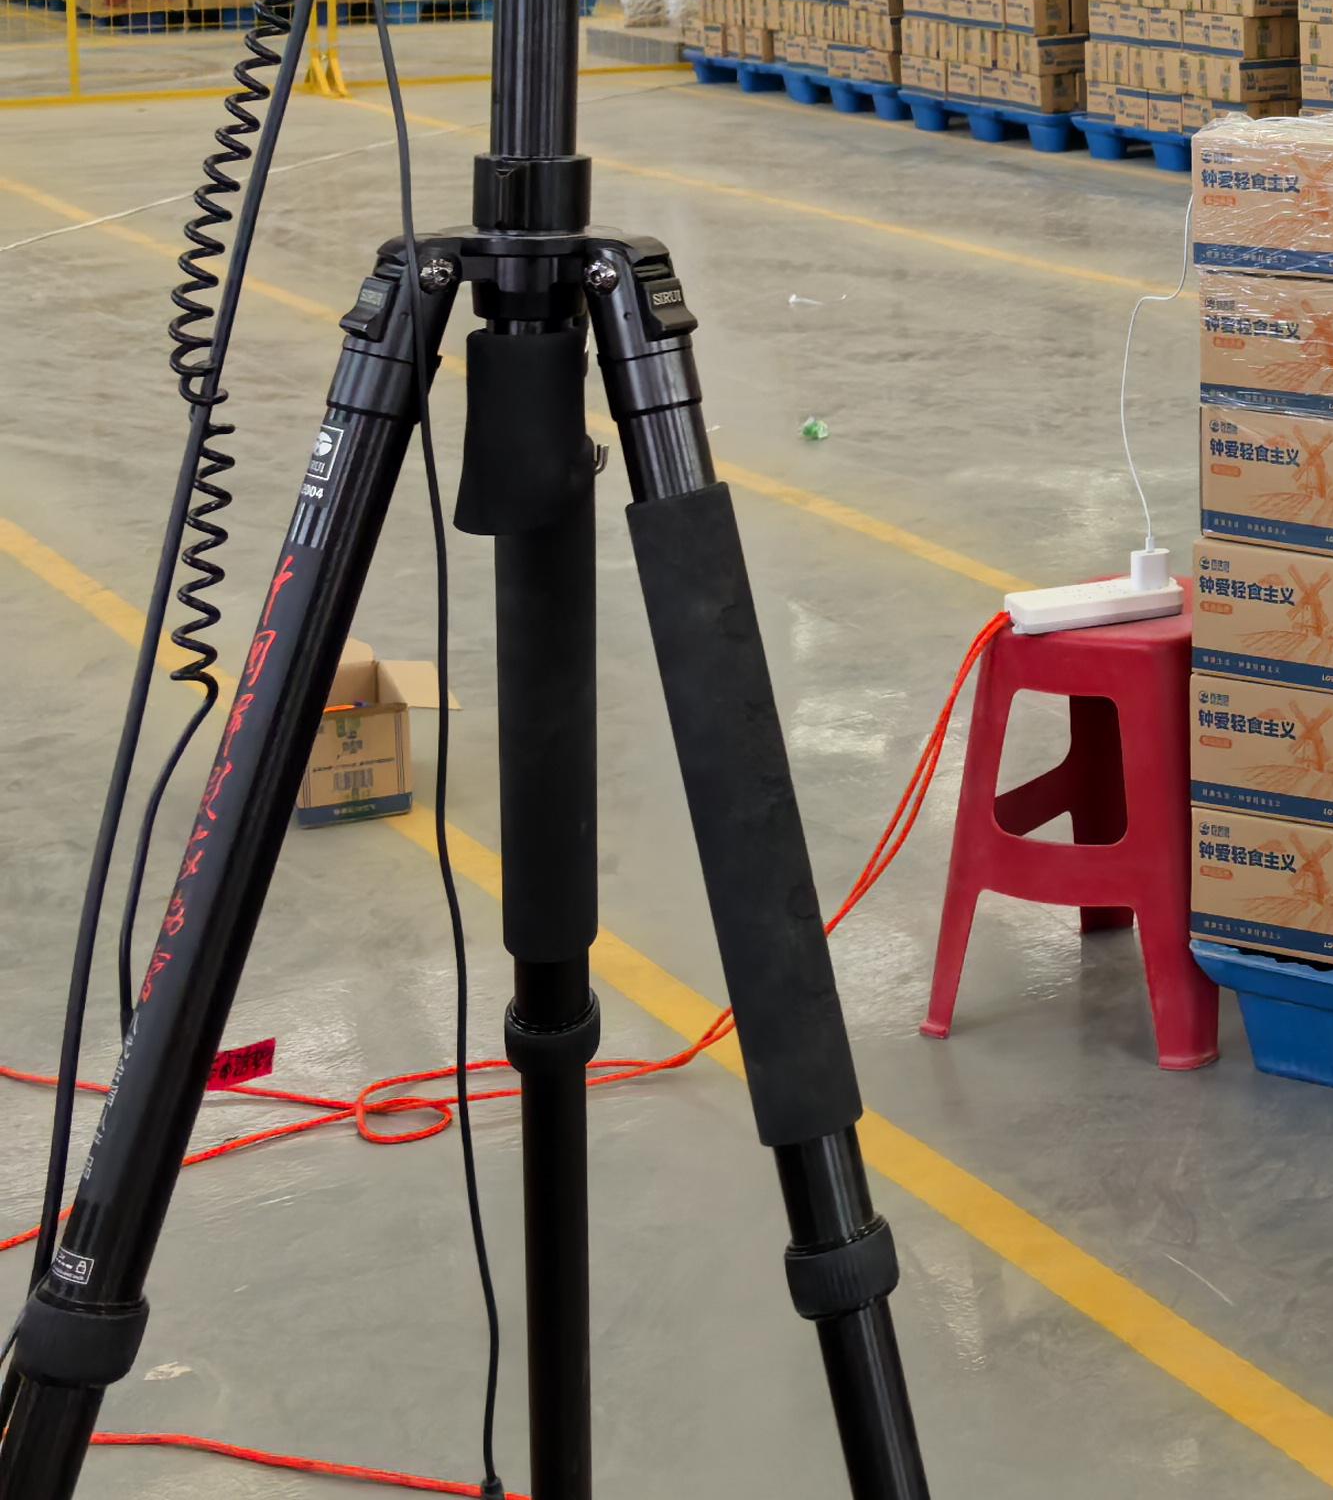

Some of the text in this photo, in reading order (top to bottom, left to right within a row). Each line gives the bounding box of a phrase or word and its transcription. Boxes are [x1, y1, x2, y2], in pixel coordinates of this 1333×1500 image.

[1211, 440, 1298, 465] 钟爱轻食主义
[1200, 576, 1294, 605] 钟爱轻食主义
[1199, 710, 1294, 738] 钟爱轻食主义
[1199, 843, 1296, 872] 钟爱轻食主义
